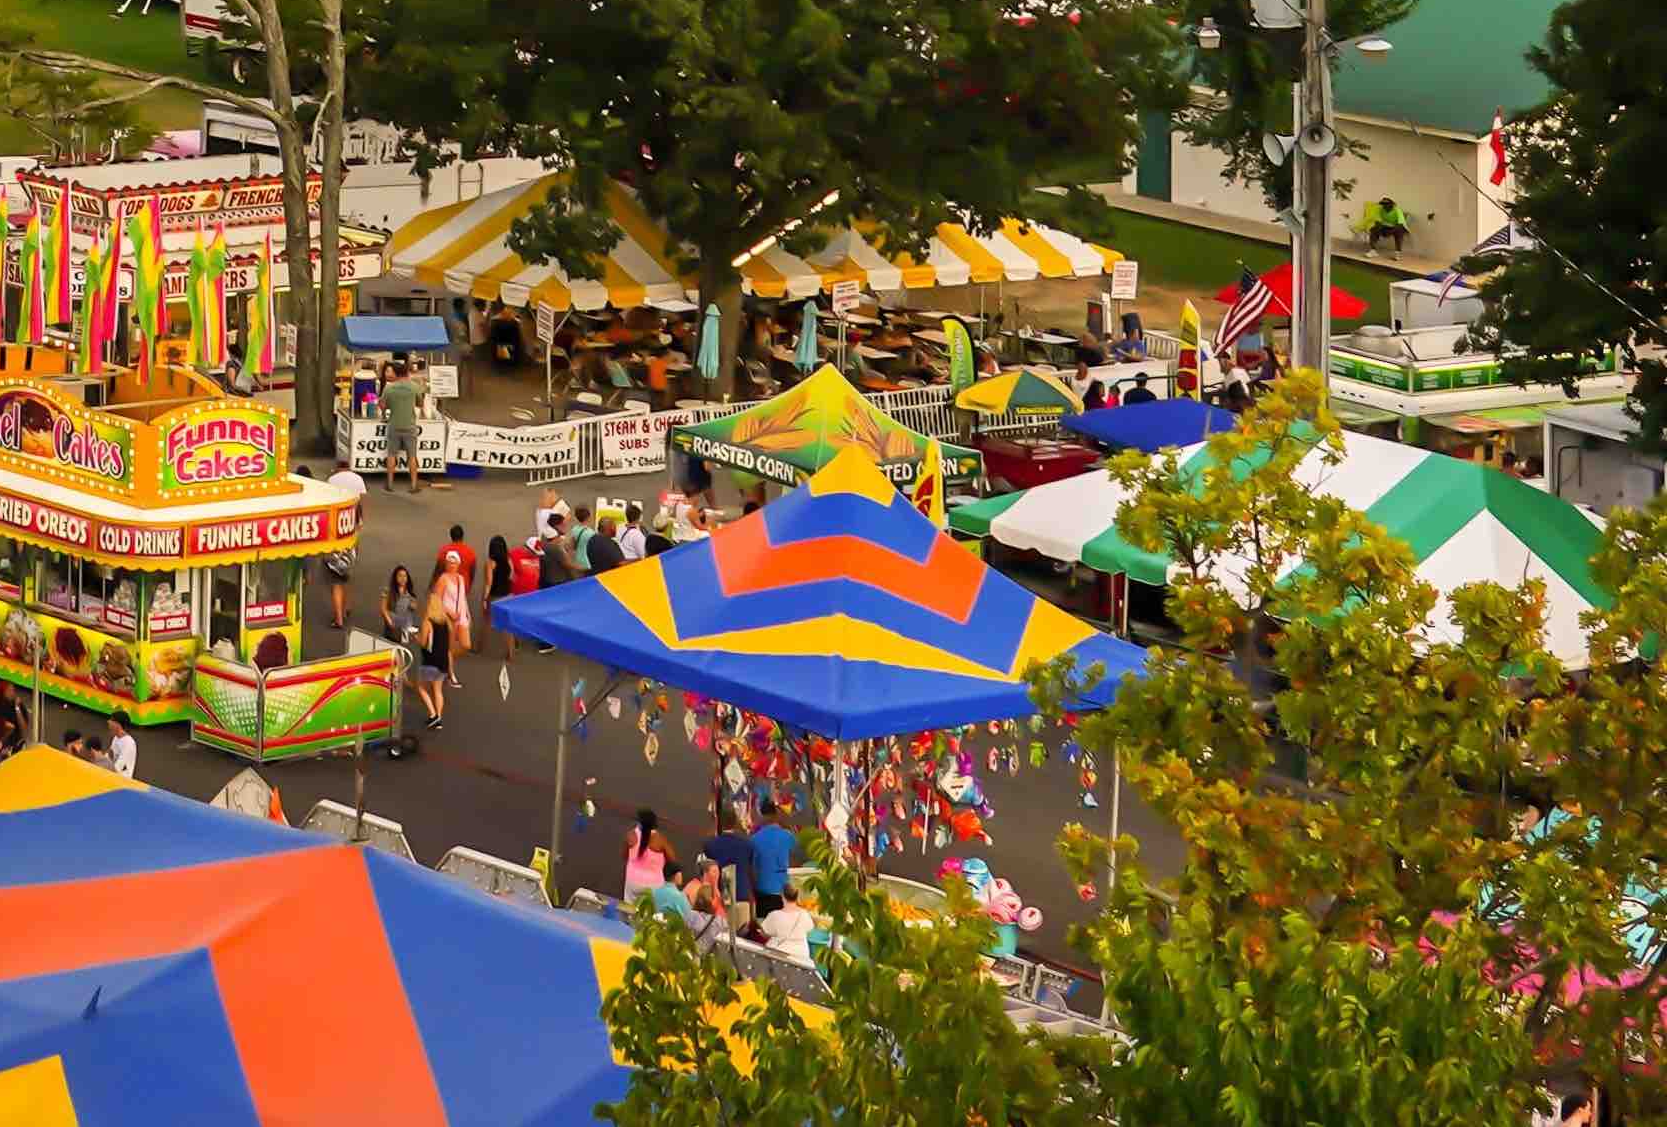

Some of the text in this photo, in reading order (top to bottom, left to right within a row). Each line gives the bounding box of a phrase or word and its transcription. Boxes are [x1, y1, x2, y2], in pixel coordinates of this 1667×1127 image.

[160, 194, 196, 213] DOGS
[229, 185, 284, 206] FRENCH
[165, 418, 276, 464] Funnel
[356, 439, 441, 451] SQUED
[604, 421, 637, 438] STEAK
[641, 421, 652, 435] &
[618, 438, 651, 451] SUBS
[51, 415, 127, 480] Cakes
[456, 447, 576, 466] LEMONADE
[691, 436, 796, 484] ROASTED CORN
[173, 449, 269, 485] Cakes
[35, 509, 89, 545] OREOS
[99, 524, 182, 555] COLD DRINKS
[196, 514, 321, 553] FUNNEL CAKES
